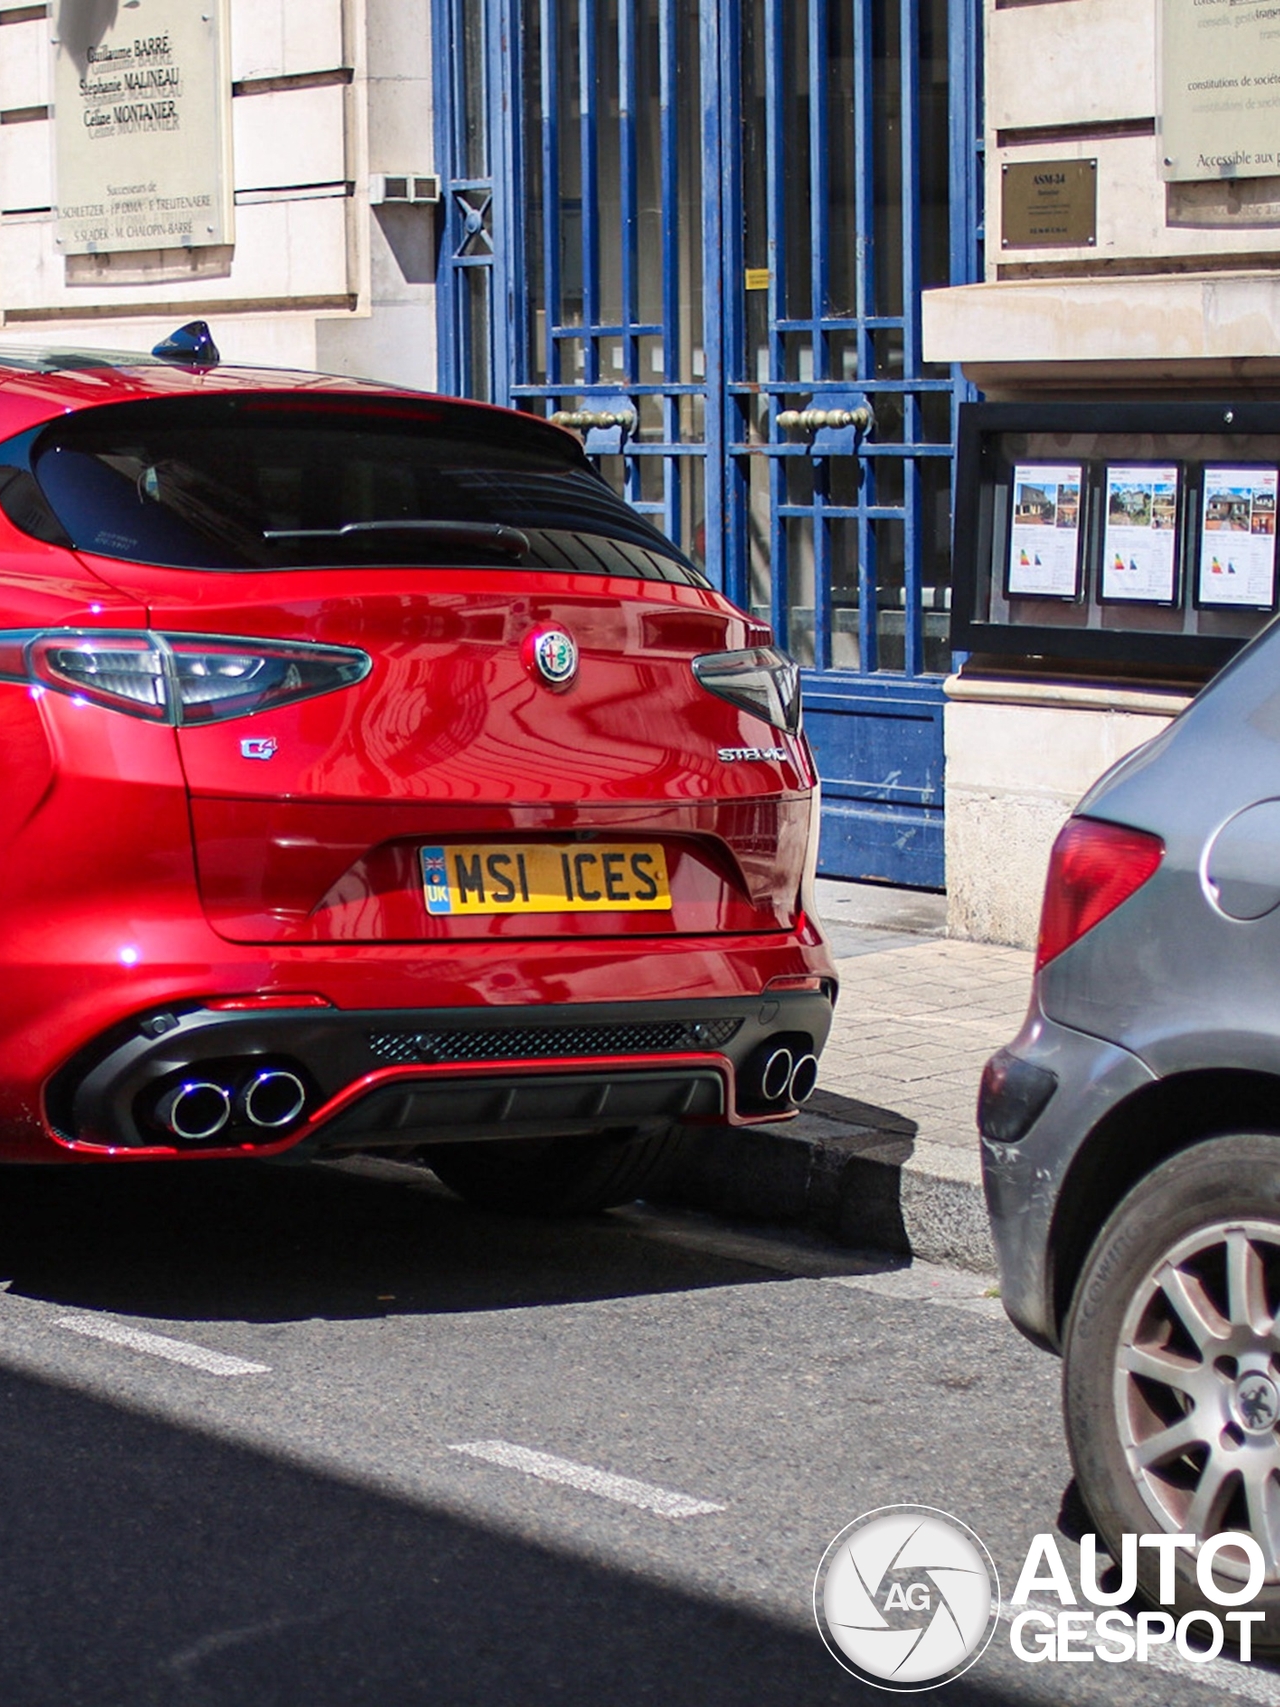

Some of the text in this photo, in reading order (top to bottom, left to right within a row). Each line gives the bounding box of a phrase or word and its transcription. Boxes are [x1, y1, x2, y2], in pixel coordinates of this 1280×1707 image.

[87, 44, 132, 63] Guillaume
[124, 67, 180, 91] MALINEAU
[1187, 79, 1239, 91] constitutions
[1240, 75, 1251, 87] de
[113, 100, 179, 124] MONTANIER
[1196, 150, 1251, 167] Accessible
[1254, 153, 1274, 164] aux
[428, 885, 448, 902] UK
